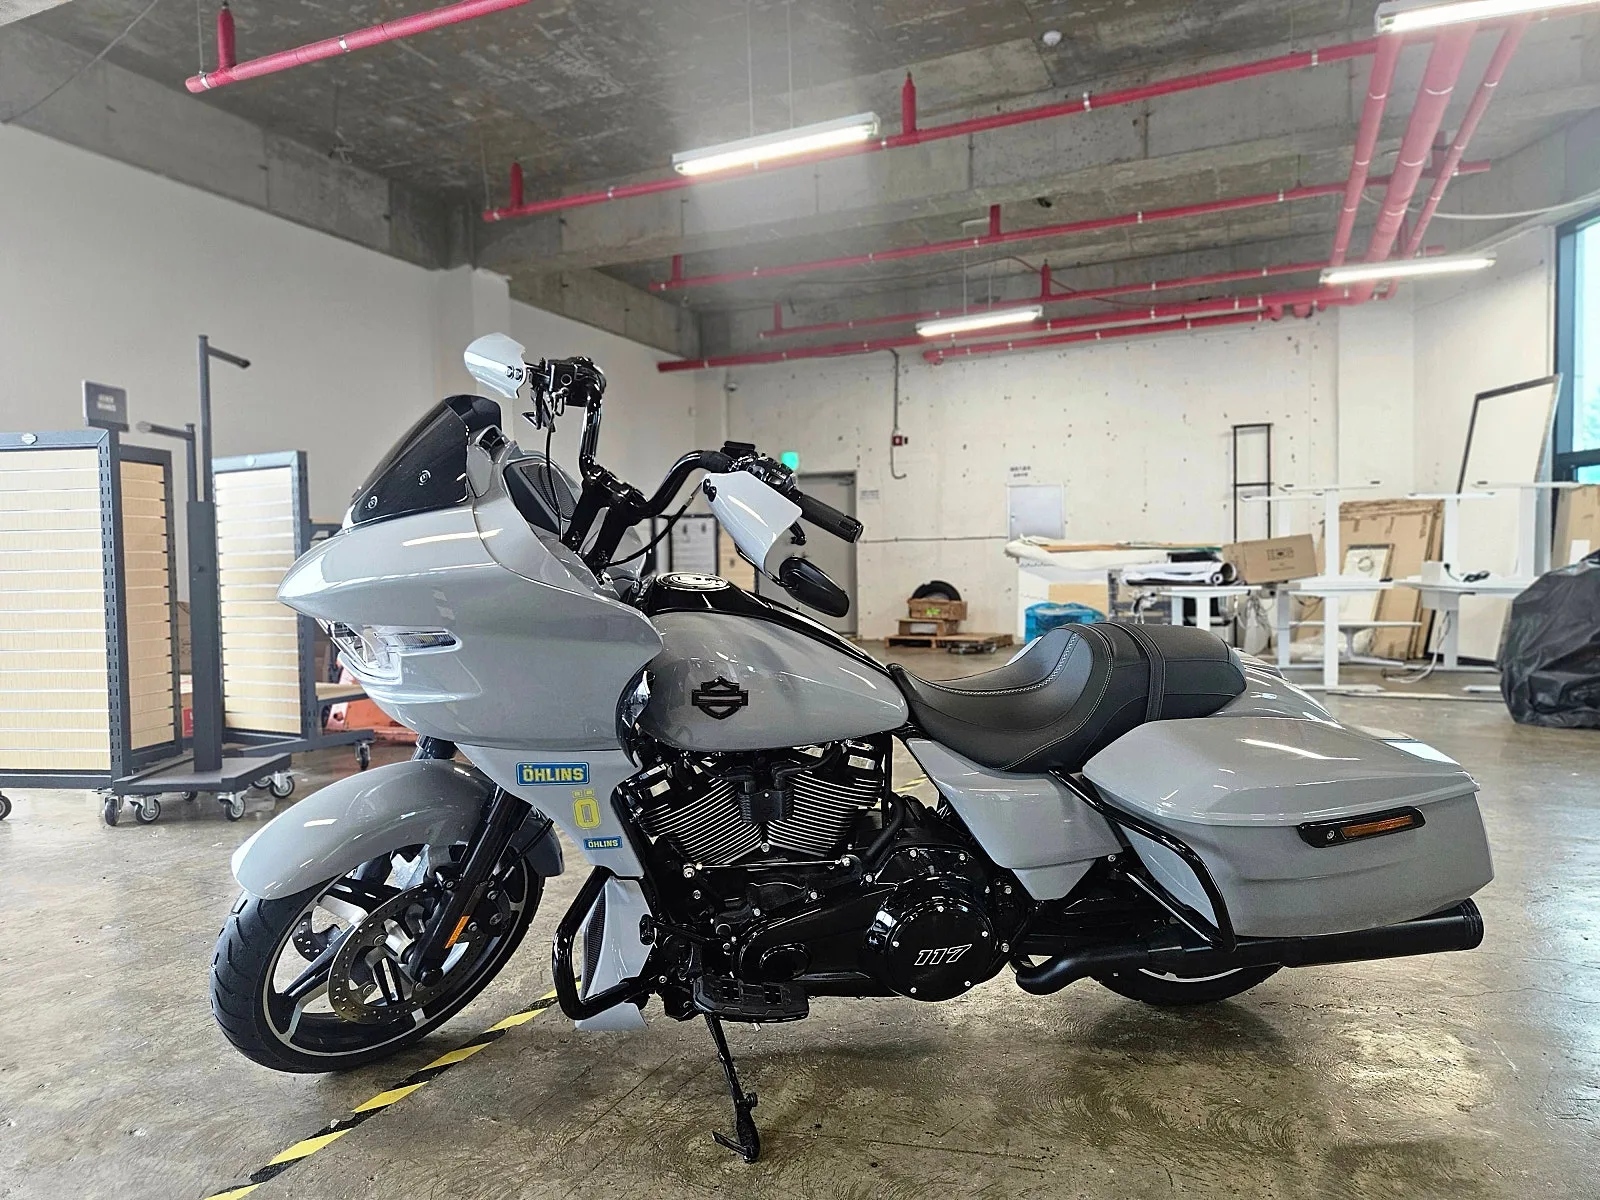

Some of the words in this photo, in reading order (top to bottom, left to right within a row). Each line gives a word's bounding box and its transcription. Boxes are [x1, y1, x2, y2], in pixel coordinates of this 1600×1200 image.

[523, 765, 584, 782] ÖHLINS
[573, 789, 601, 829] Ö
[588, 839, 619, 848] ÖHLINS
[914, 943, 973, 966] 117
